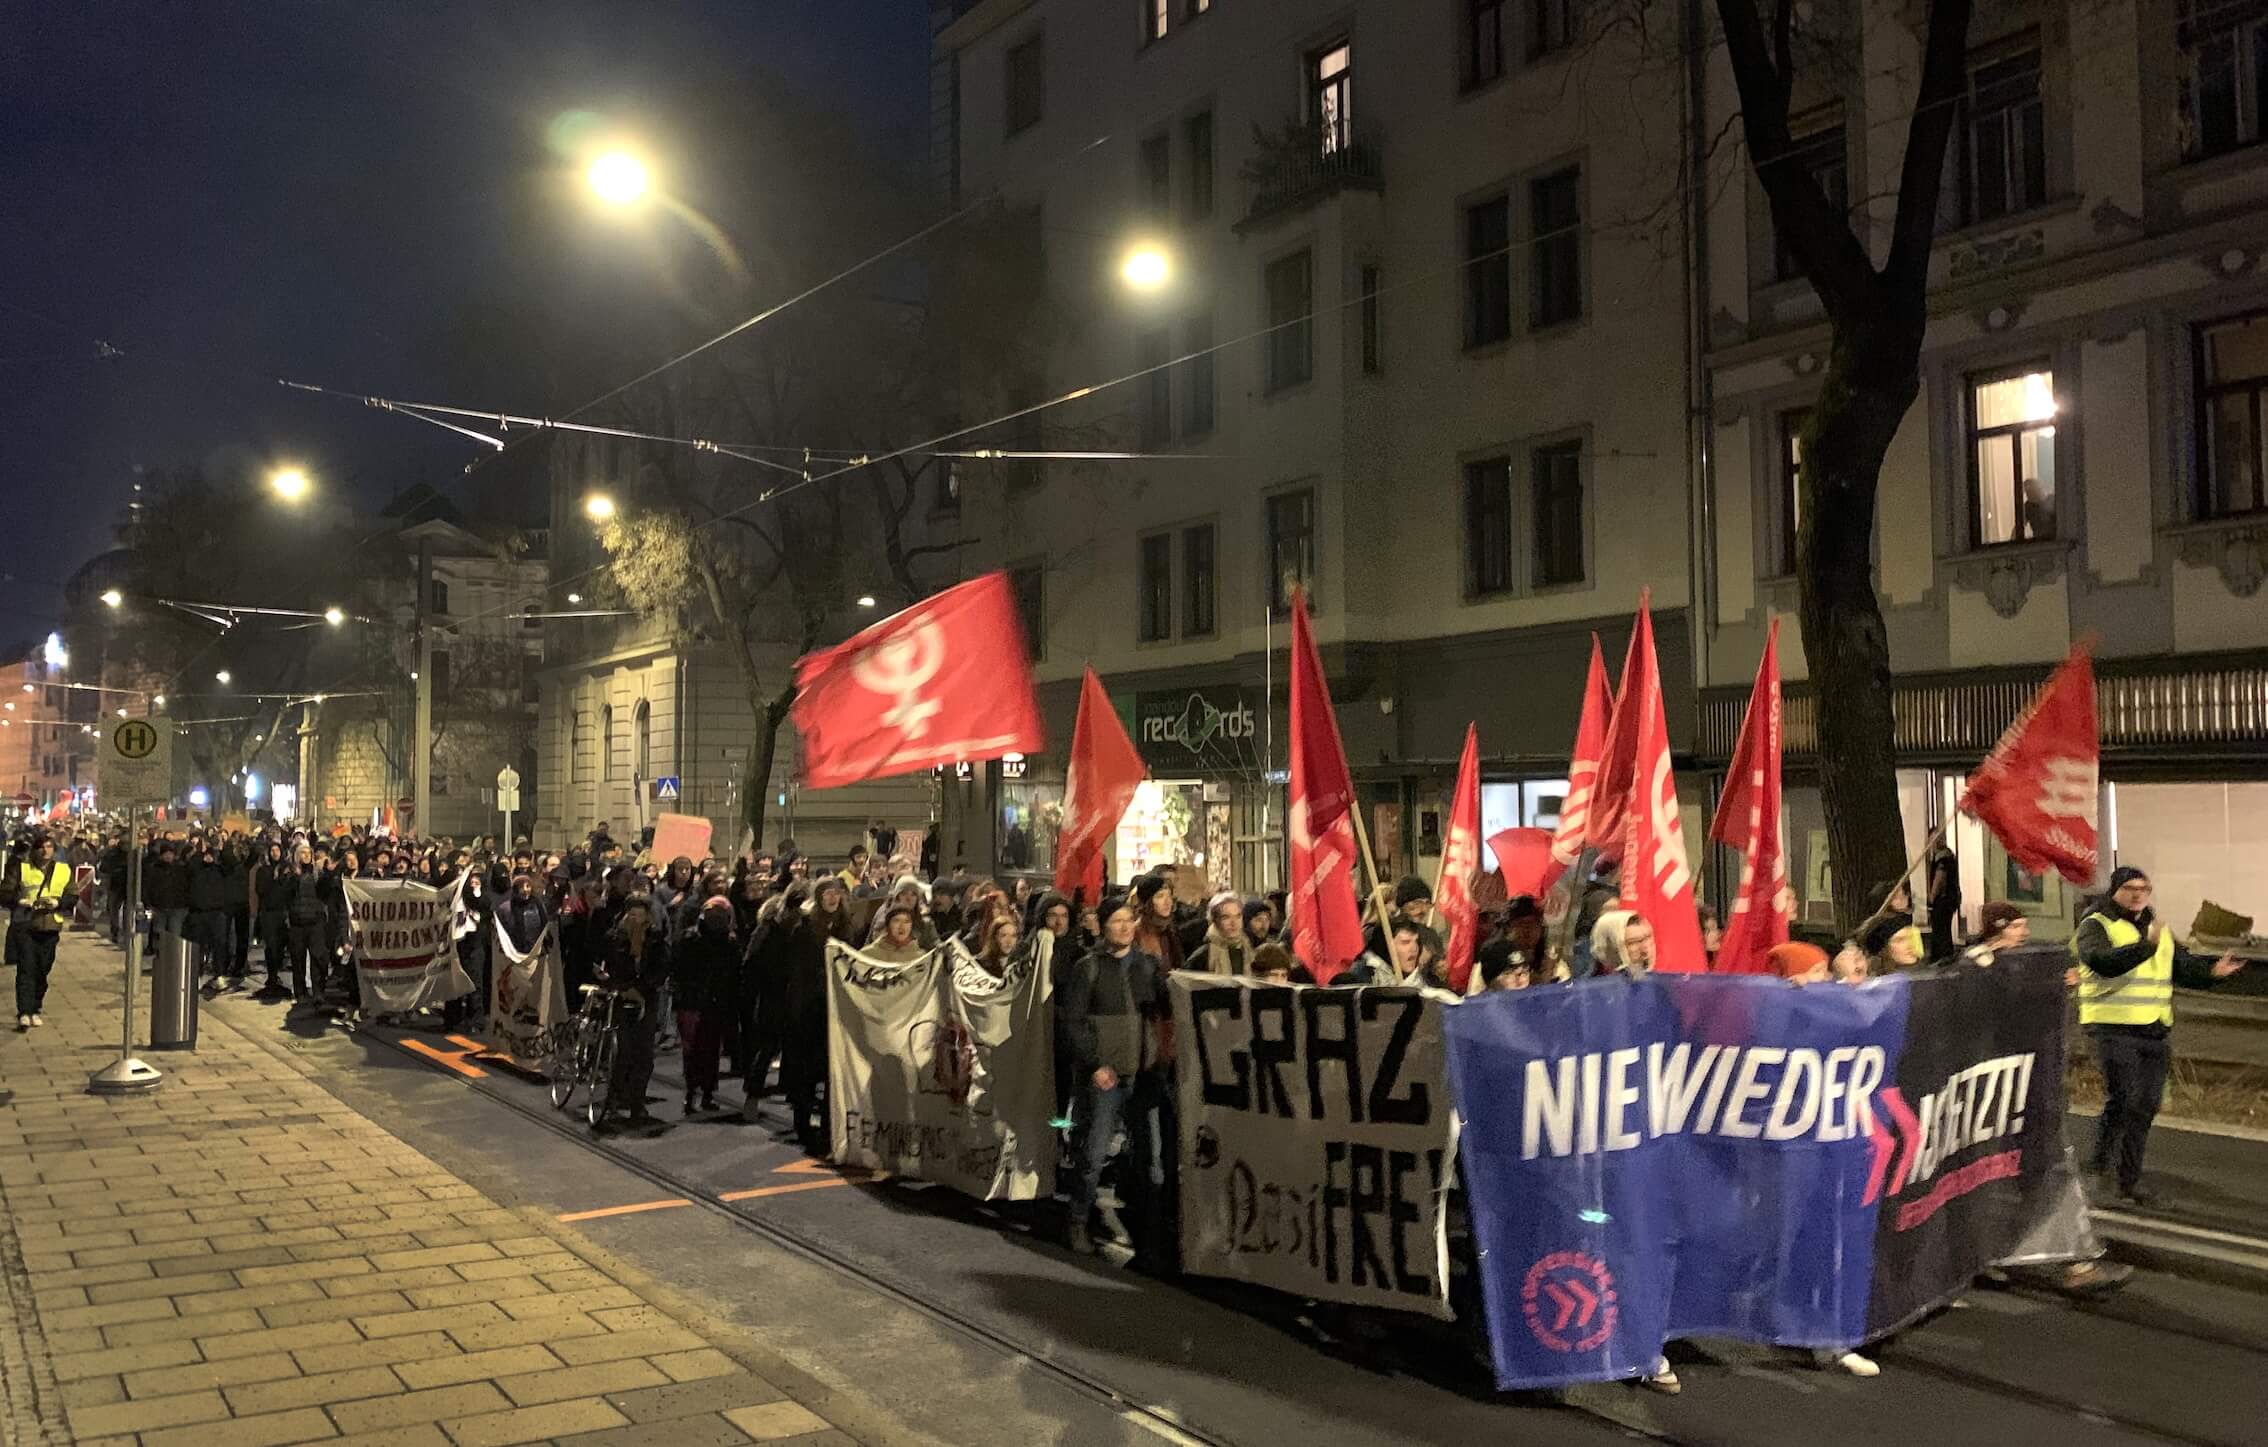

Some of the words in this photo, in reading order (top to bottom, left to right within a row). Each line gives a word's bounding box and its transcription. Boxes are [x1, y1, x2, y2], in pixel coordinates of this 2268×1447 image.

[125, 728, 145, 751] H
[1191, 986, 1431, 1125] GRAZ
[1520, 1047, 1641, 1160] NIE
[1647, 1041, 1886, 1142] WIEDER
